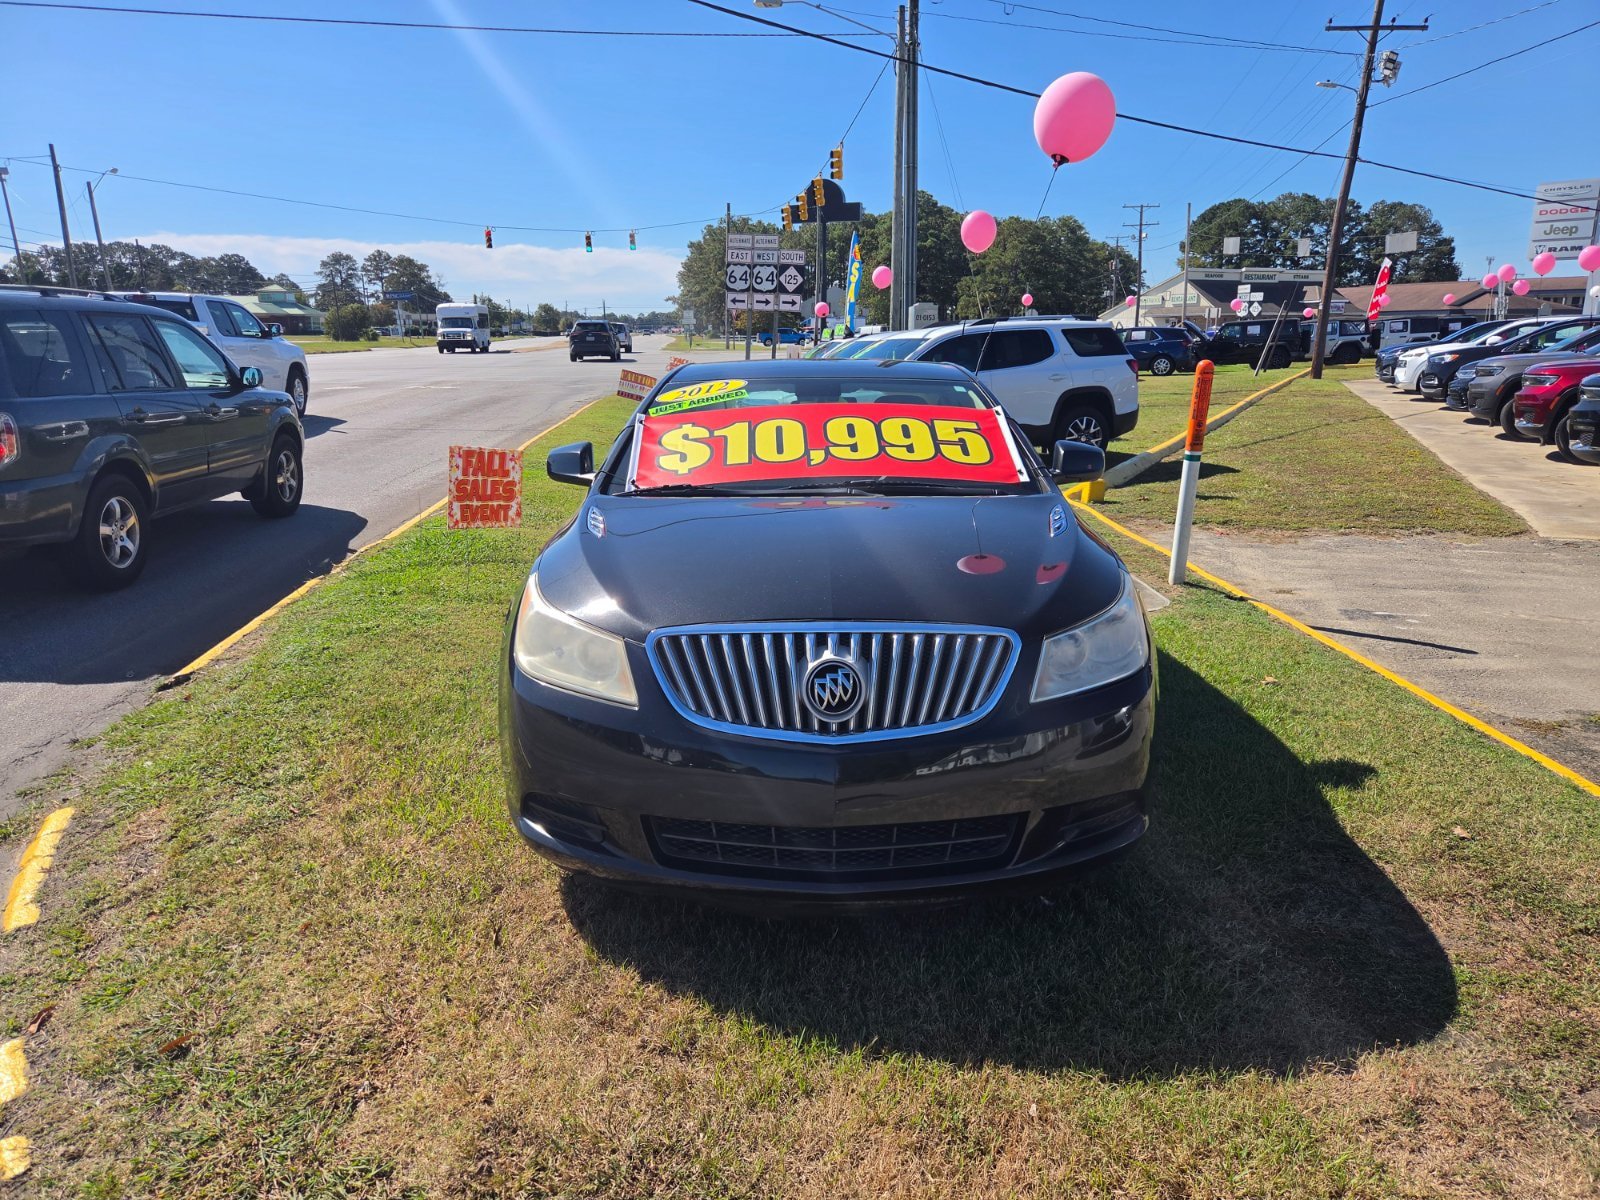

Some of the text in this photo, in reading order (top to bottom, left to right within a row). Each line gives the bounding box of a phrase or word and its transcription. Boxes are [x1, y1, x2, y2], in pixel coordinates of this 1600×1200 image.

[1544, 184, 1592, 192] CHRYSLER
[1539, 207, 1589, 216] DODGE
[1543, 224, 1579, 236] Jeep
[1547, 245, 1584, 253] RAM
[731, 251, 749, 260] EAST
[756, 252, 775, 261] WEST
[781, 252, 804, 261] SOUTH
[728, 270, 749, 285] 64
[754, 270, 775, 285] 64
[784, 274, 799, 285] 125
[1244, 273, 1277, 281] RESTAURANT
[675, 381, 730, 400] 2012
[651, 390, 745, 415] JUST ARRIVED
[656, 415, 994, 476] $10,995
[461, 449, 510, 478] FALL
[455, 478, 517, 503] SALES
[459, 503, 511, 523] EVENT
